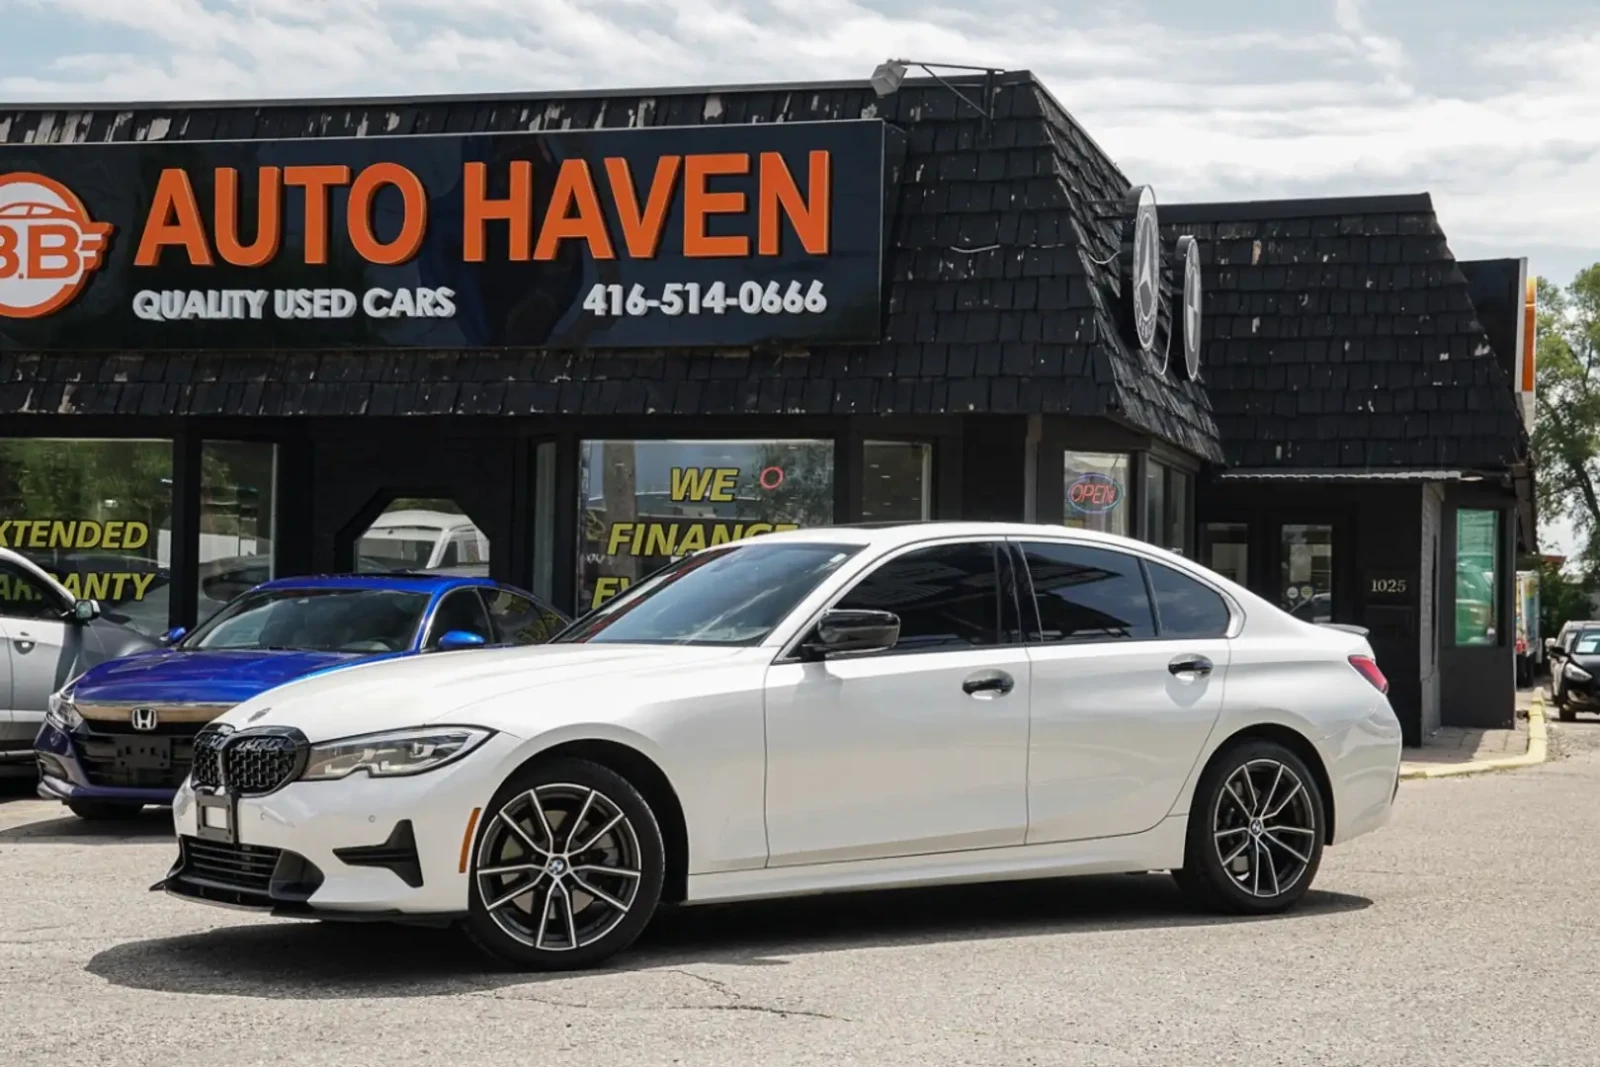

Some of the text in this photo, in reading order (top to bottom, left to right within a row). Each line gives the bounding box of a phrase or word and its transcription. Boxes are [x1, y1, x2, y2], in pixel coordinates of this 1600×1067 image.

[134, 150, 830, 266] AUTO HAVEN
[132, 286, 457, 322] QUALITY USED CARS
[583, 279, 828, 316] 416-514-0666
[670, 467, 739, 502] WE
[1069, 483, 1117, 505] OPEN
[606, 522, 799, 557] FINAN
[1370, 579, 1407, 593] 1025
